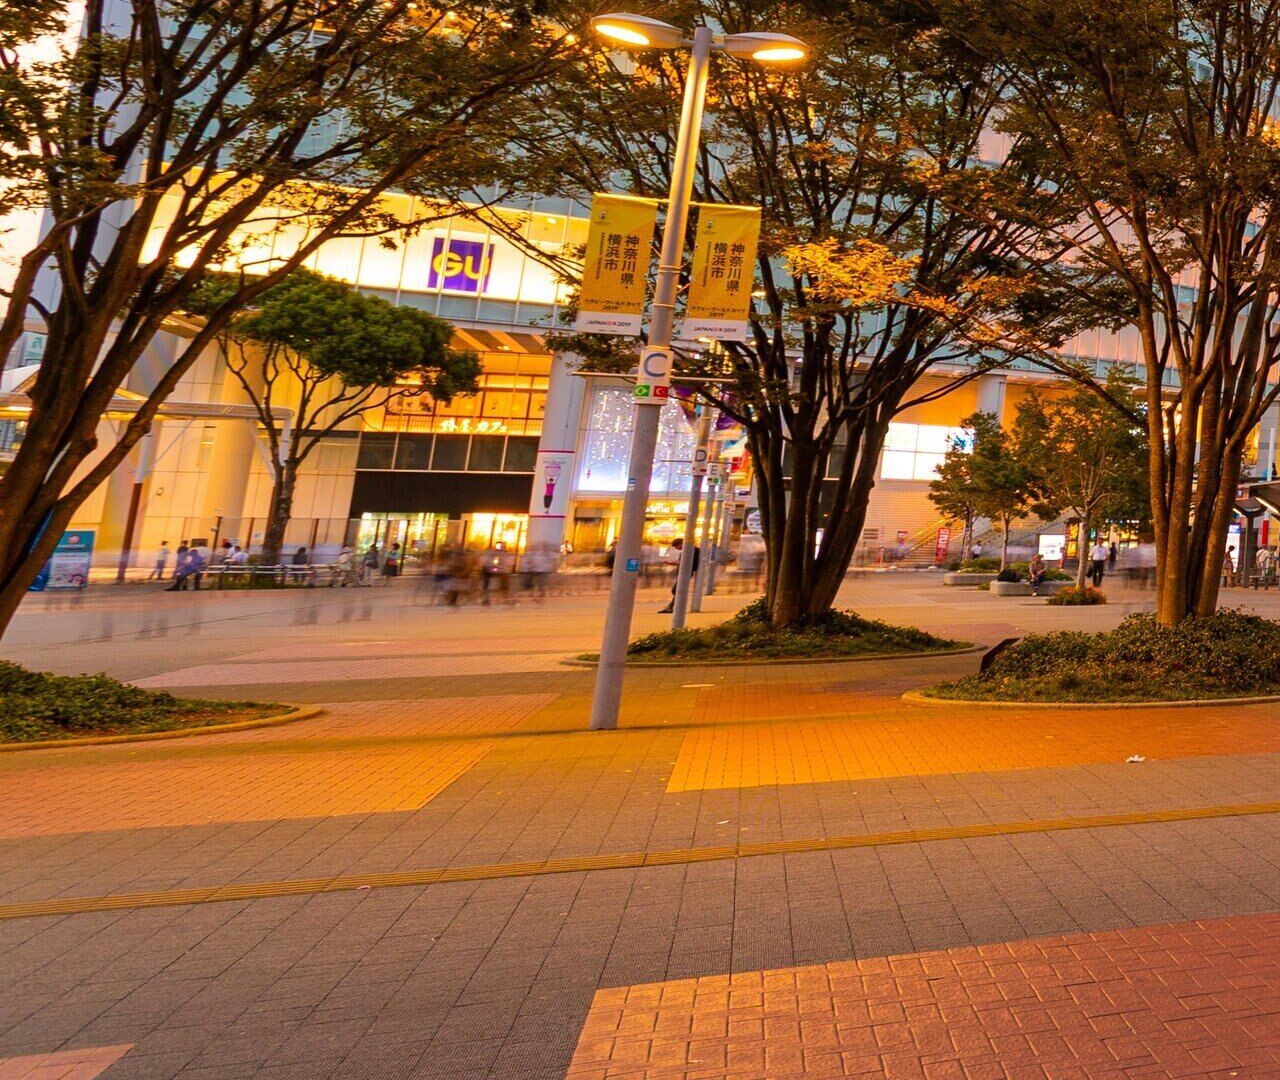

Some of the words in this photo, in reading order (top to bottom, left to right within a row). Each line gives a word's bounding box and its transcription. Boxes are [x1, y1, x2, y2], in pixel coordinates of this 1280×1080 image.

[433, 251, 490, 280] GU
[604, 233, 622, 271] 横浜市
[711, 242, 728, 279] 横浜市
[644, 352, 668, 377] C
[695, 449, 707, 462] D
